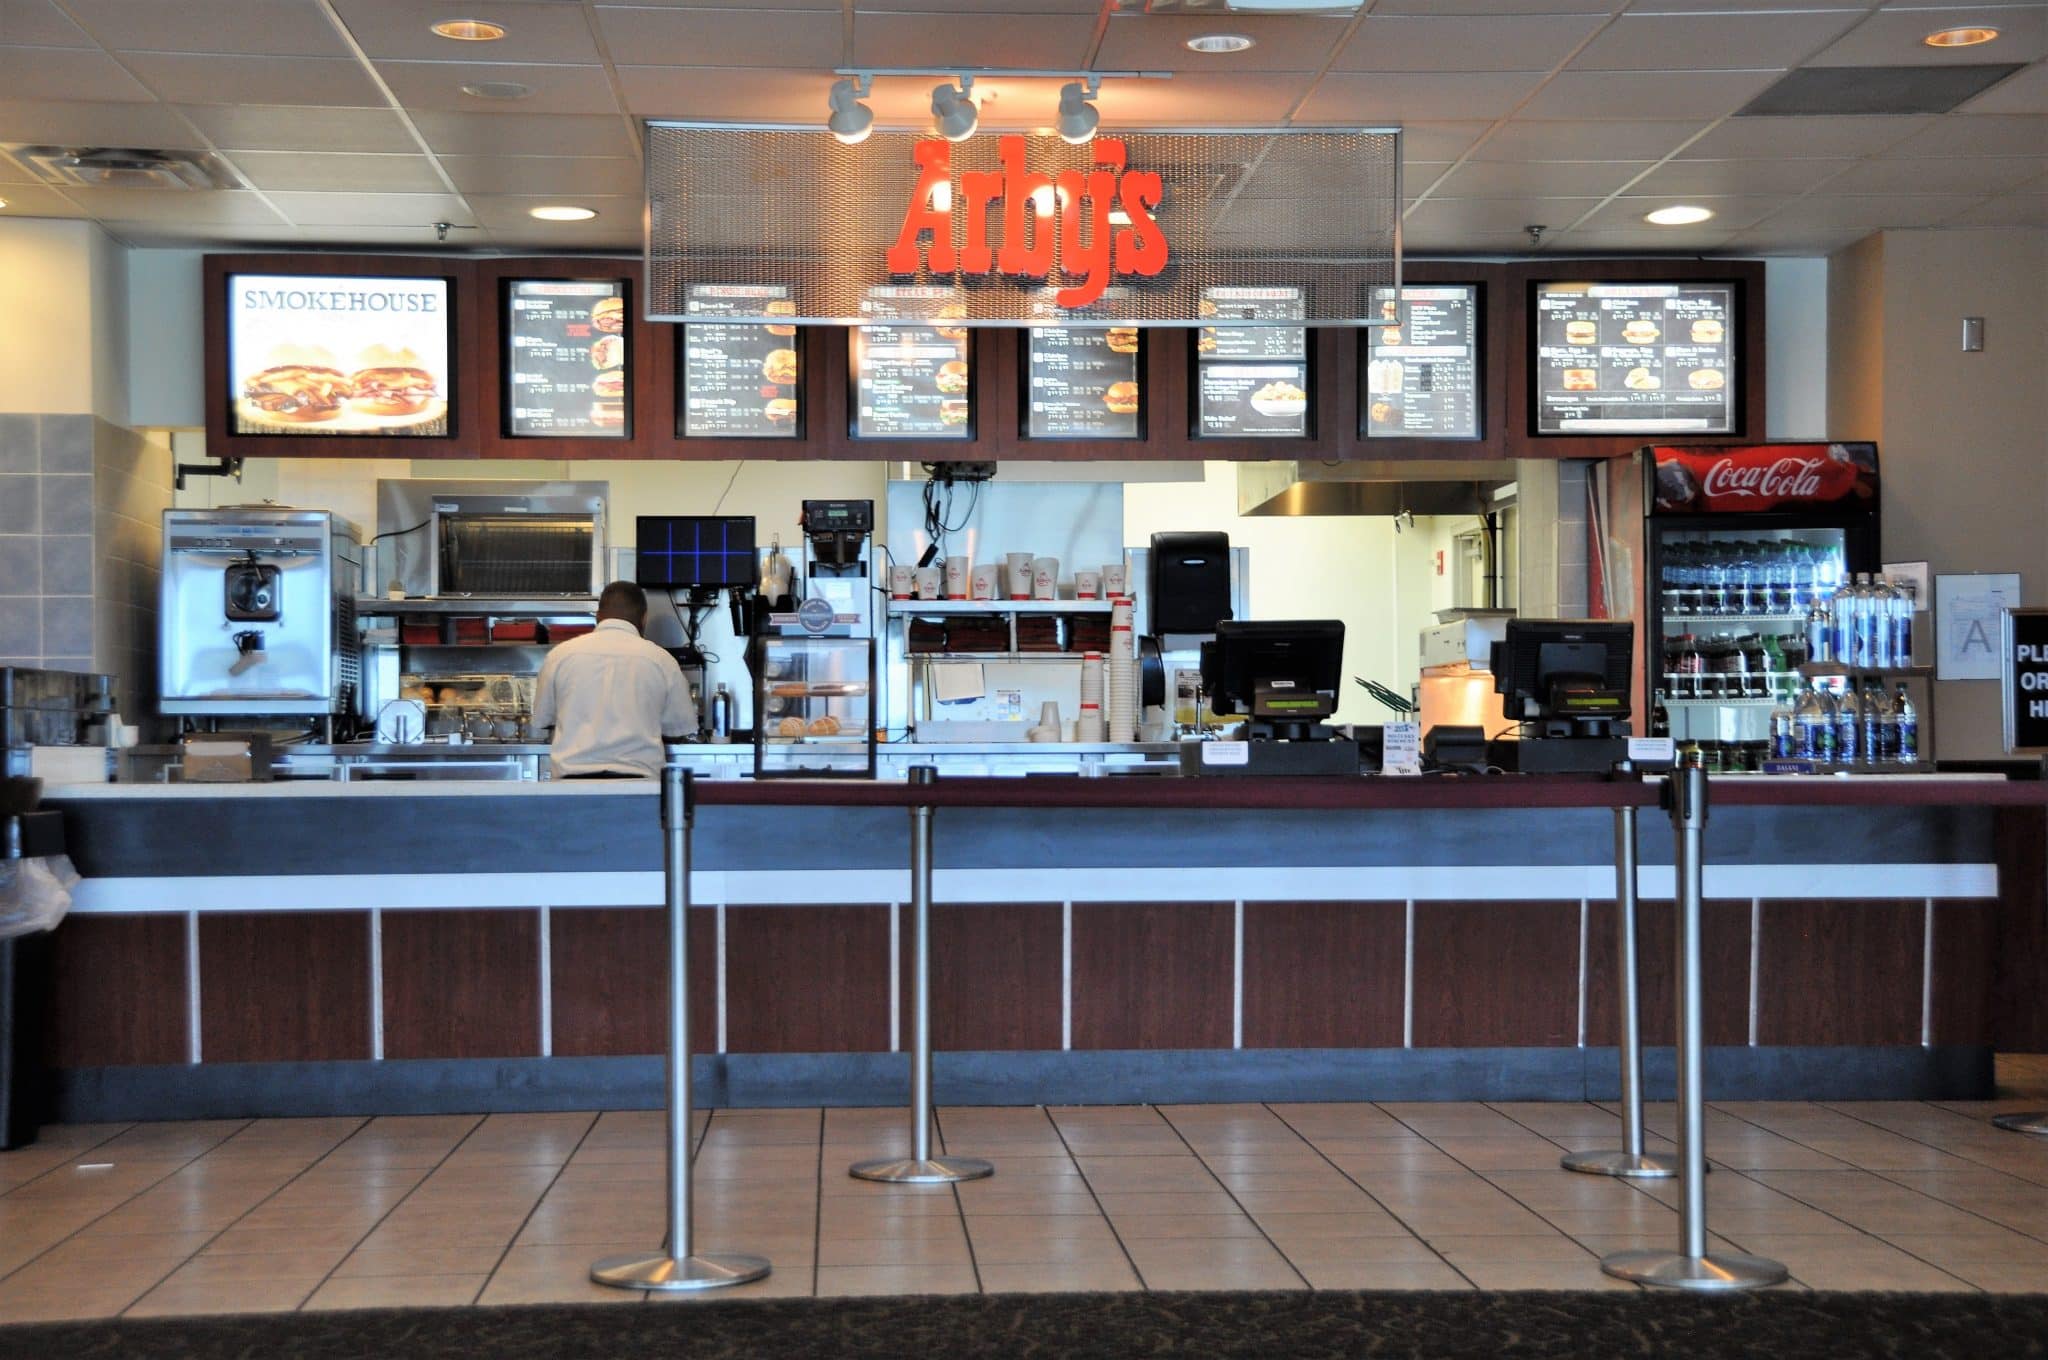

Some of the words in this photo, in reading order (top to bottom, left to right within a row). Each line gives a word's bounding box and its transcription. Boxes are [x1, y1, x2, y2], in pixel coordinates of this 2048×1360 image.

[887, 135, 1168, 309] Arby's
[244, 290, 437, 312] SMOKEHOUSE
[1703, 458, 1825, 497] Coca-Cola
[1961, 619, 1992, 653] A
